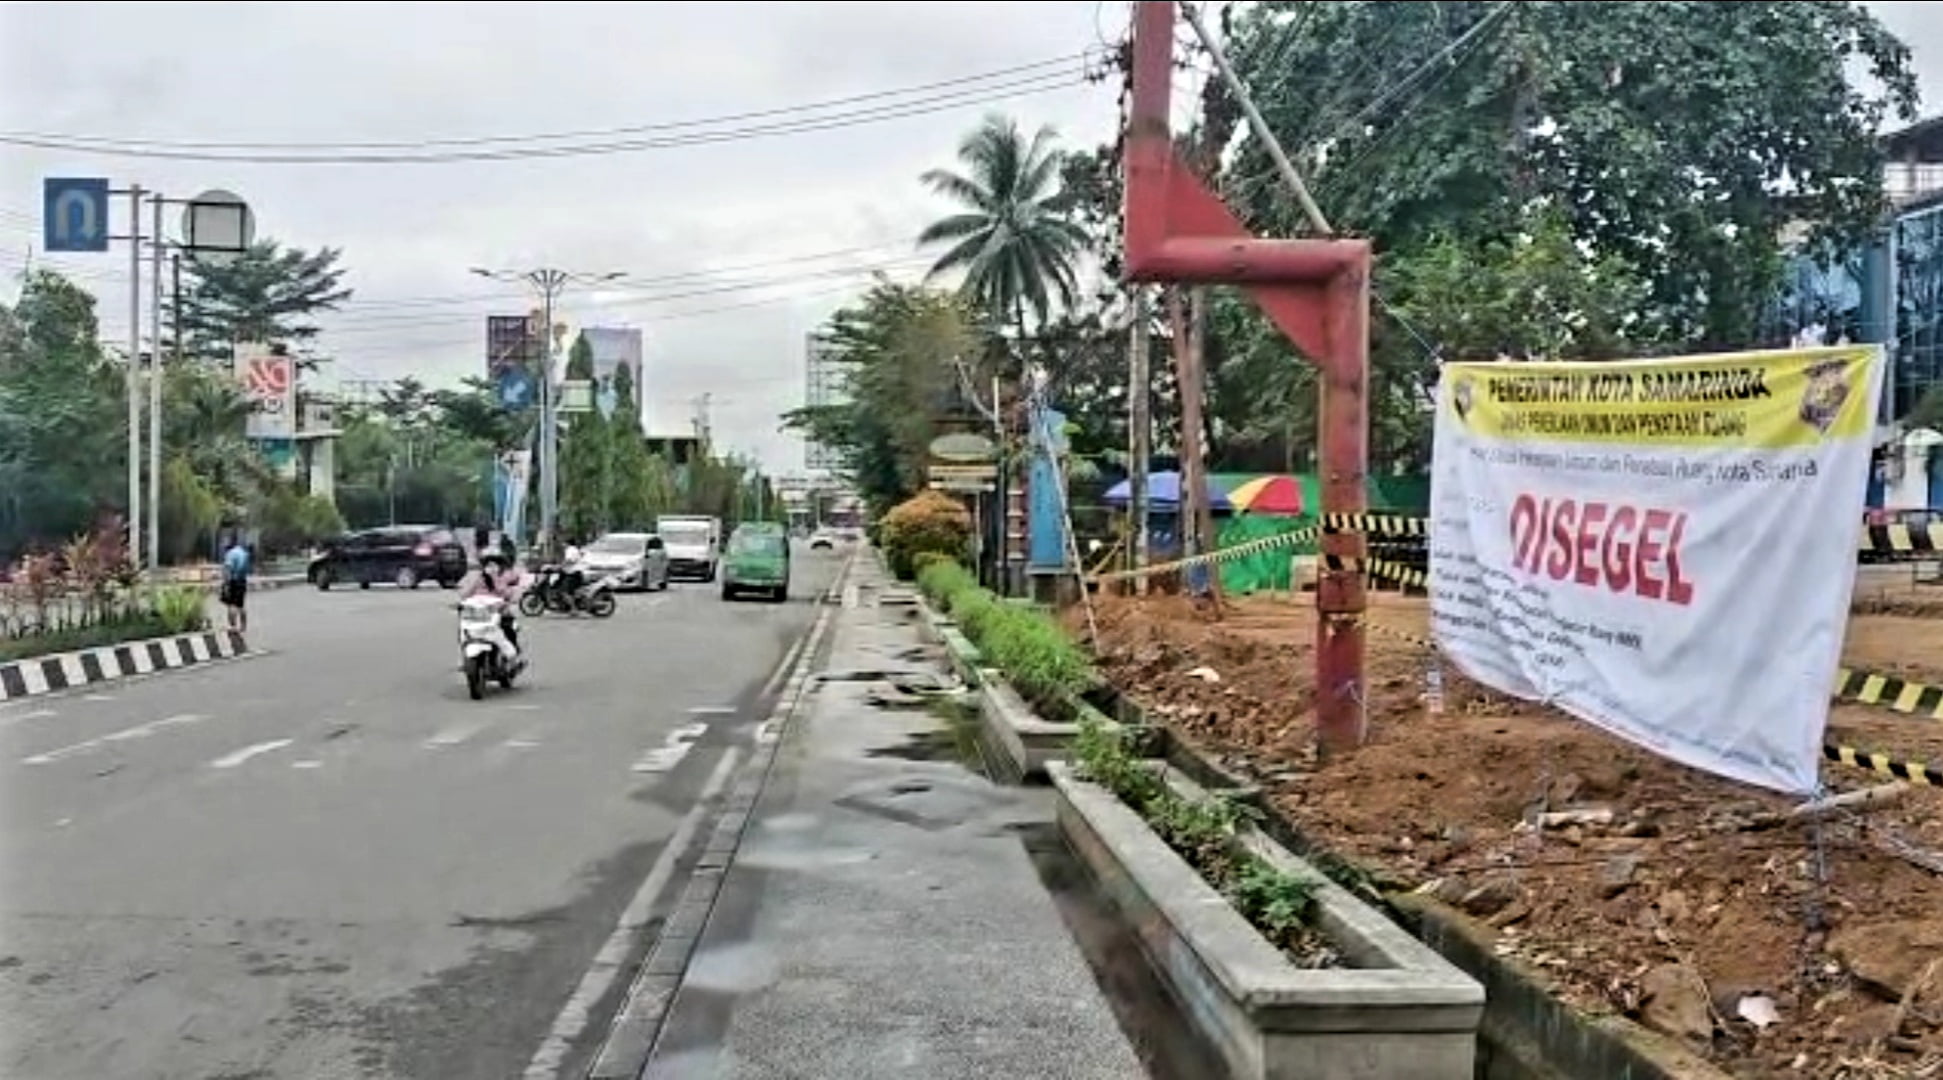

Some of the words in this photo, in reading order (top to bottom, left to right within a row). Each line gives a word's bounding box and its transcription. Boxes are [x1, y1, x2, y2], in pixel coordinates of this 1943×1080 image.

[1489, 375, 1582, 402] PEMERINTAH
[1586, 373, 1634, 402] KOTA
[1510, 493, 1694, 606] DISEGEL
